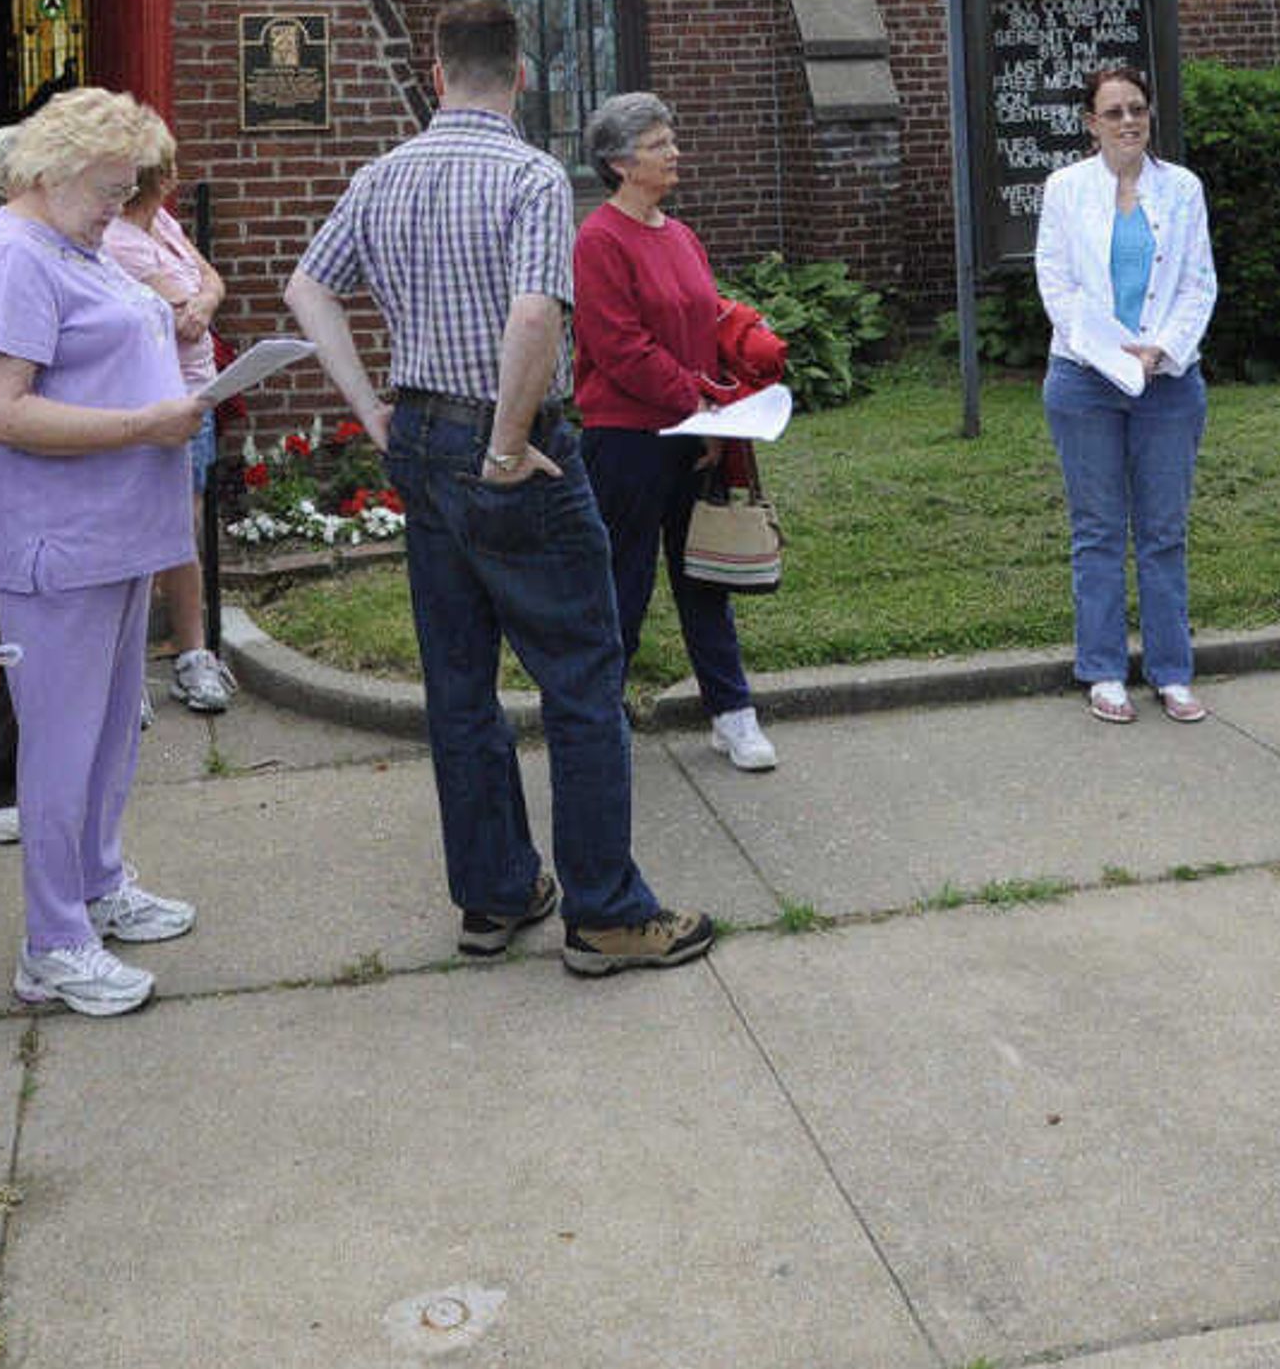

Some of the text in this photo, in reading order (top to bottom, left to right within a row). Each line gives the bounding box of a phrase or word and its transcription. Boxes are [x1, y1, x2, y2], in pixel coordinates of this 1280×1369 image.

[1091, 25, 1140, 42] MASS
[1072, 41, 1098, 56] PM
[1005, 59, 1044, 77] LAST
[993, 74, 1037, 92] FREE
